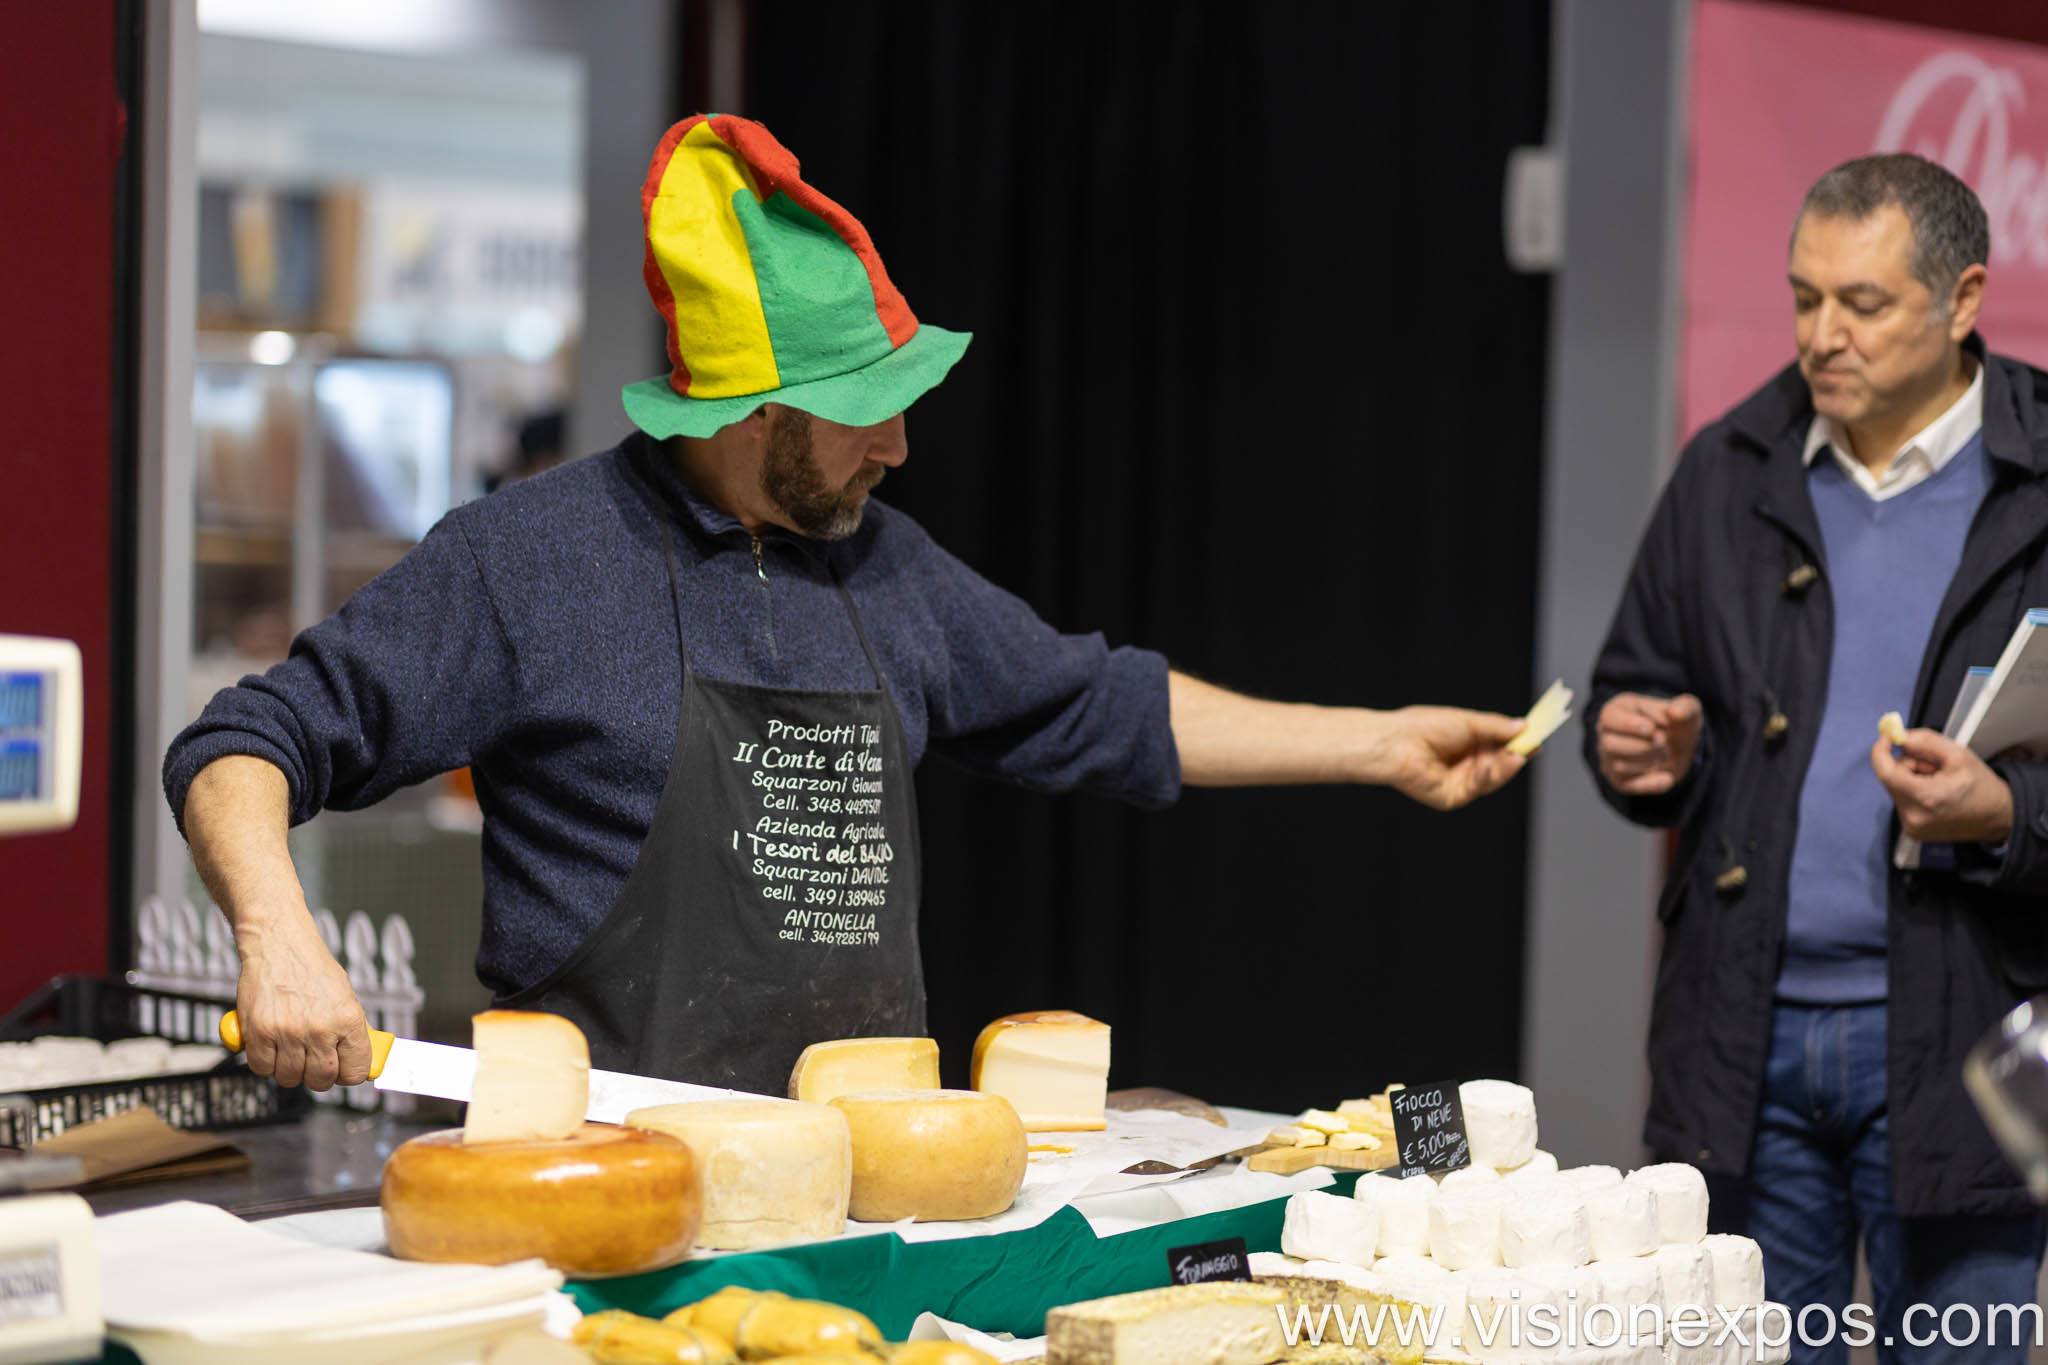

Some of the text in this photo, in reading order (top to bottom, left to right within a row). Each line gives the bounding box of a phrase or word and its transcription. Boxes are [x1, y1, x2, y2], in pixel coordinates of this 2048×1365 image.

[767, 719, 856, 744] Prodotti
[732, 741, 759, 763] Il
[761, 746, 827, 770] Conte
[834, 750, 854, 772] di
[751, 770, 848, 793] Squarzoni
[762, 793, 800, 811] Cell.
[755, 815, 886, 844] Azienda Agricola
[746, 832, 820, 862] Tesori
[825, 843, 857, 865] del
[752, 858, 890, 885] Squarzoni DAVIDE
[762, 884, 797, 902] cell.
[783, 908, 876, 931] ANTONELLA
[778, 928, 806, 942] cell.
[1394, 1089, 1443, 1115] FIOCCO
[1410, 1102, 1453, 1133] DI NEVE
[1402, 1142, 1417, 1165] €
[1417, 1130, 1446, 1160] 5,00
